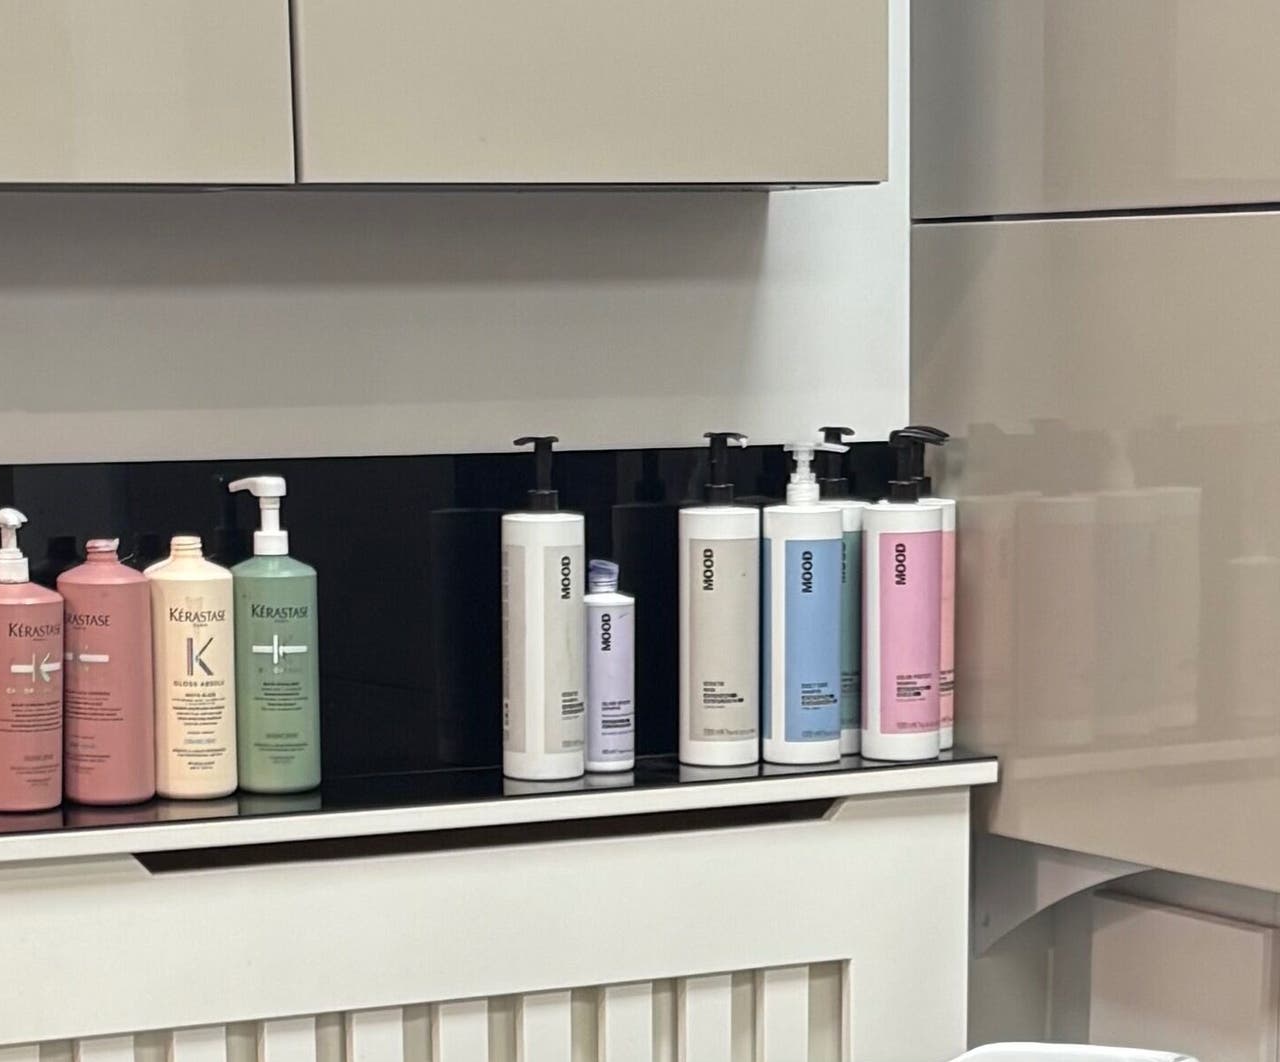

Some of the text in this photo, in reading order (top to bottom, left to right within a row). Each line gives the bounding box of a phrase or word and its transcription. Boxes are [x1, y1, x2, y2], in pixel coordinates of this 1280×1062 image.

[561, 555, 571, 600] MOOD
[703, 548, 714, 591] MOOD
[802, 550, 813, 593] MOOD
[895, 543, 906, 585] MOOD
[169, 607, 226, 623] KÉRASTASE
[251, 604, 308, 619] KÉRASTASE
[601, 613, 612, 651] MOOD
